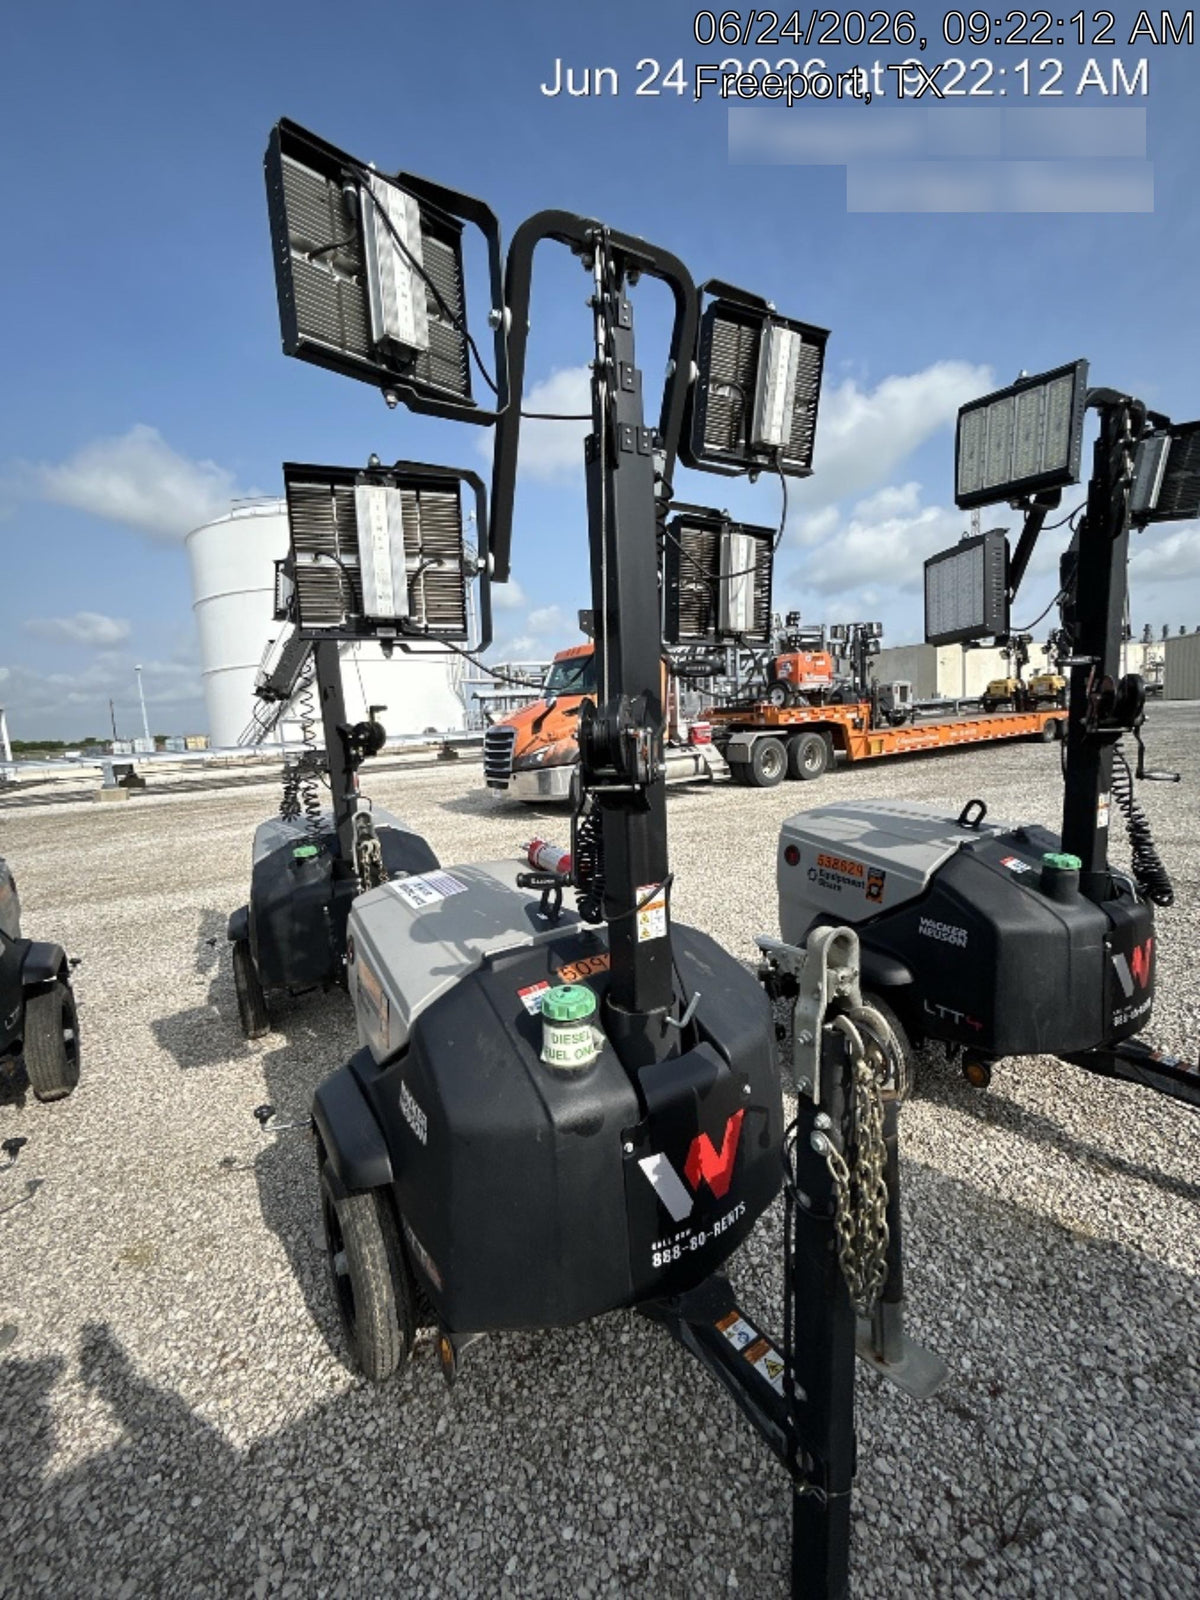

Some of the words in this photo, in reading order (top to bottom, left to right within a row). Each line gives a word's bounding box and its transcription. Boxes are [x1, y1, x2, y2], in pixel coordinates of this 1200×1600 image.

[918, 925, 968, 949] NEUSON
[920, 916, 969, 937] WACKER
[560, 953, 610, 981] 509
[550, 1030, 590, 1046] DIESEL
[651, 1200, 747, 1269] 888-80-RENTS
